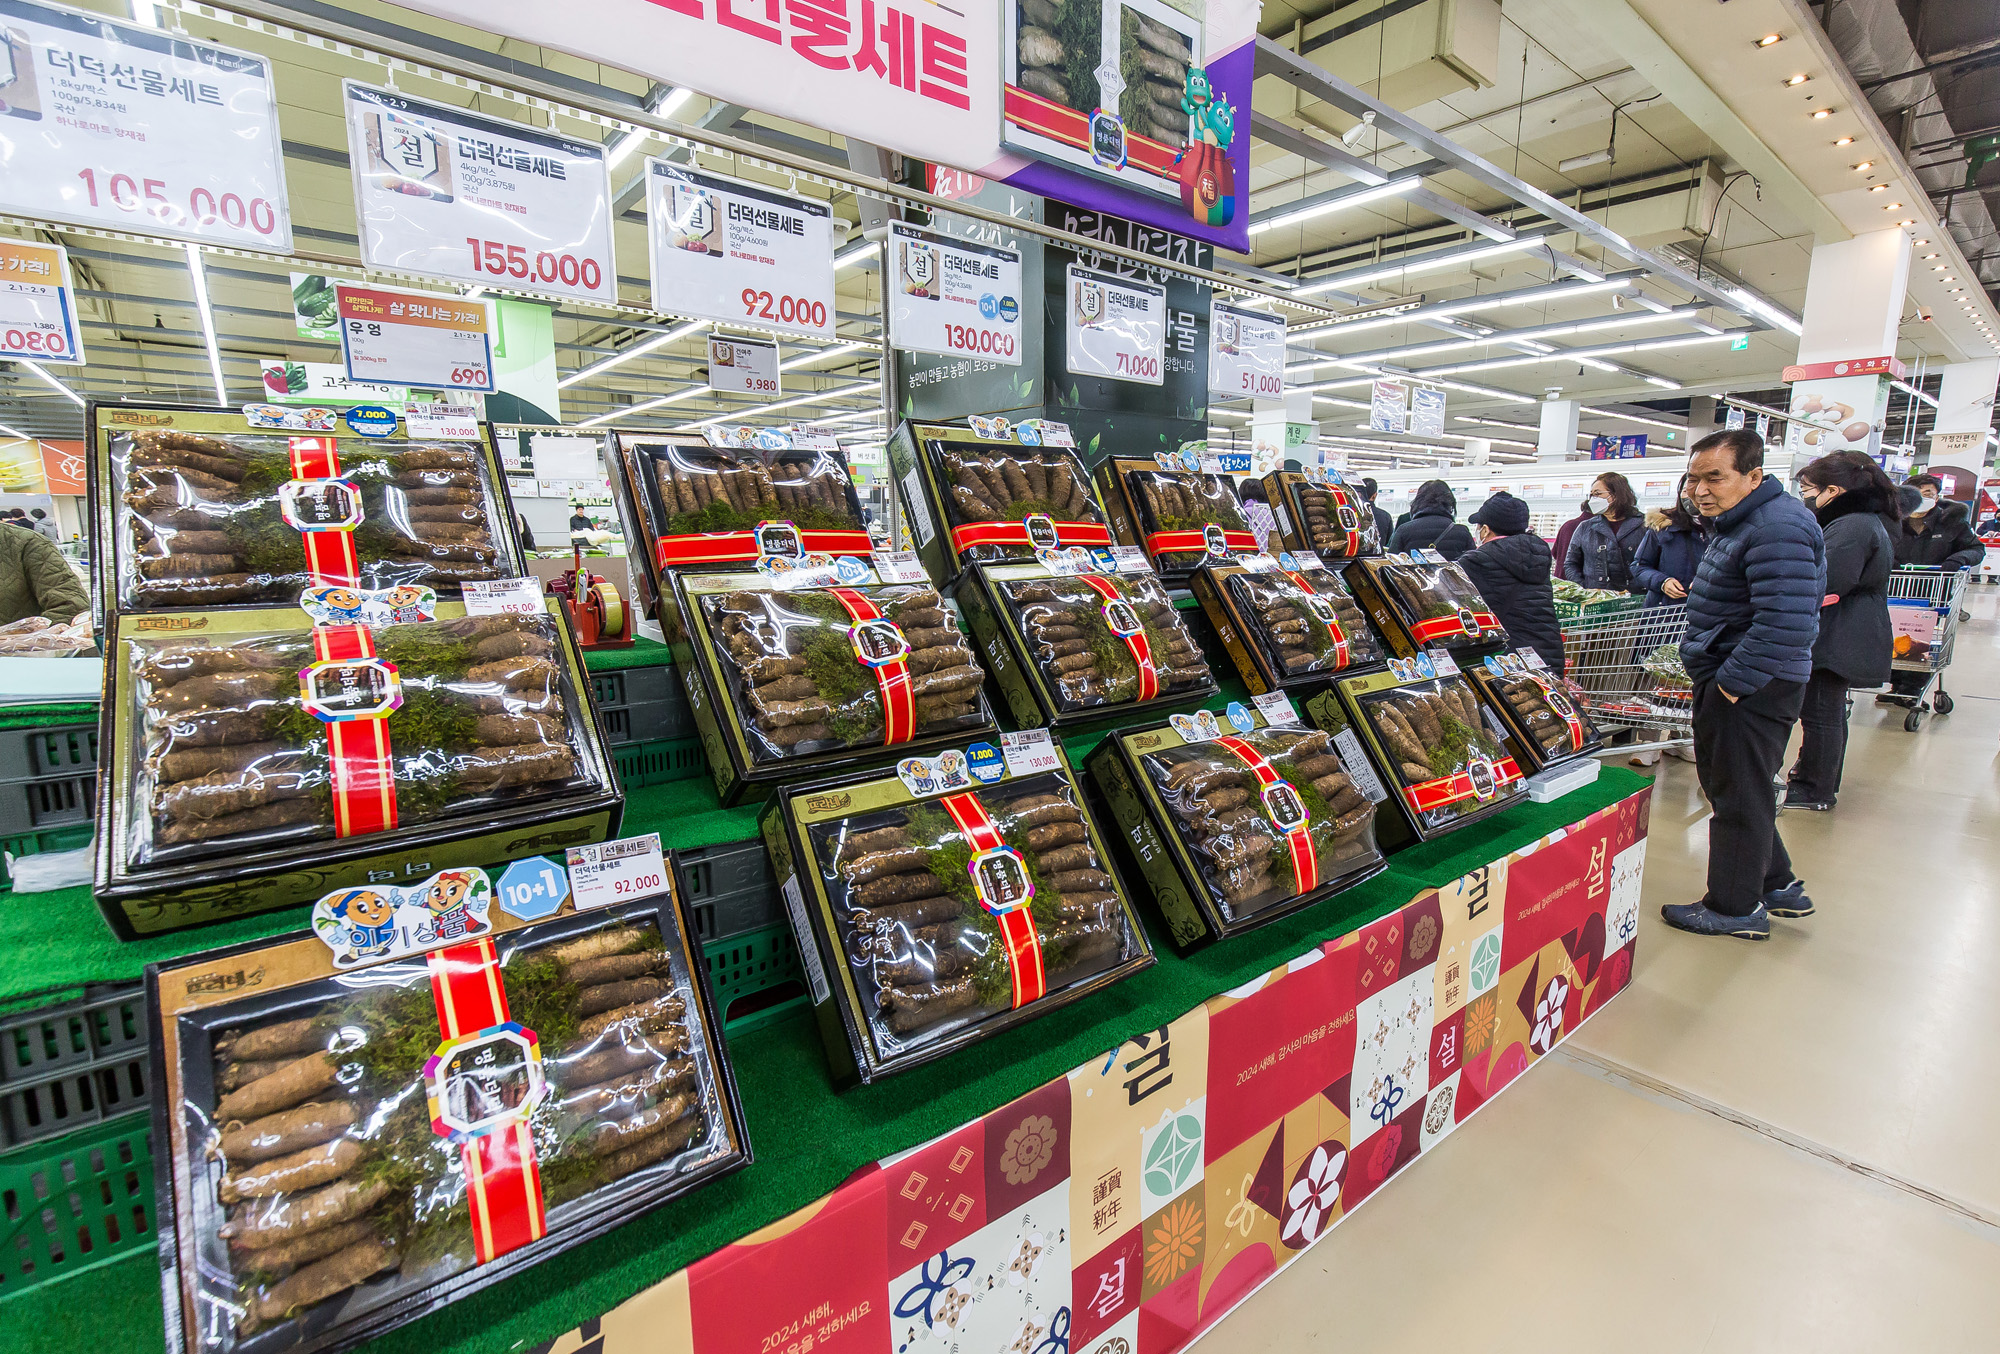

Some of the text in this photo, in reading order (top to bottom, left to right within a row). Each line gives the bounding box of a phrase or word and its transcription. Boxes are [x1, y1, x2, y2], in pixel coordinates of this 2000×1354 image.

[47, 48, 225, 107] 더덕선물세트
[54, 103, 76, 116] 국산
[56, 116, 146, 142] 하나로마트 양재점
[393, 135, 425, 169] 설
[458, 136, 566, 181] 더덕선물세트
[460, 162, 496, 177] 4kg/박스
[78, 167, 275, 235] 105,000
[463, 184, 479, 194] 국산
[1202, 178, 1215, 201] 福
[504, 202, 527, 215] 양재점
[728, 202, 804, 236] 더덕선물세트
[730, 241, 741, 250] 국산
[8, 256, 50, 276] 가격!
[466, 237, 601, 290] 155,000
[730, 251, 775, 265] 하나로마트 양재점
[912, 256, 927, 278] 설
[944, 254, 999, 280] 더덕선물세트
[345, 296, 374, 305] 대한민국
[741, 288, 826, 328] 92,000
[980, 299, 996, 314] 10+1
[1084, 293, 1096, 312] 설
[1108, 291, 1149, 312] 더덕선물세트
[389, 301, 480, 325] 살 맛나는 가격!
[1, 329, 65, 353] ,080
[945, 324, 1014, 356] 130,000
[908, 370, 928, 389] 농민이
[928, 366, 949, 384] 만들고
[950, 359, 972, 379] 농협이
[1116, 352, 1158, 377] 71,000
[451, 368, 487, 386] 690
[745, 378, 777, 391] 9,980
[1242, 373, 1281, 394] 51,000
[441, 428, 476, 437] 130,000
[1021, 431, 1038, 443] 10+1
[765, 539, 796, 549] 명품더덕
[1231, 708, 1251, 726] 10+1
[1029, 756, 1055, 768] 130,000
[604, 840, 647, 856] 선물세트
[575, 861, 622, 875] 더덕선물세트
[993, 859, 1014, 900] 명품더덕
[1583, 837, 1607, 900] 설
[505, 869, 558, 906] 10+1
[614, 874, 660, 894] 92,000
[1456, 864, 1489, 920] 설
[349, 906, 469, 958] 인기상품
[1236, 1008, 1356, 1087] 2024 새해, 감사의 마음을 전하세요
[1436, 1025, 1456, 1069] 설
[1101, 1025, 1174, 1106] 설
[1093, 1171, 1122, 1205] 謹賀
[1093, 1196, 1122, 1230] 新年
[1087, 1257, 1126, 1319] 설
[761, 1300, 834, 1354] 2024 새해,
[817, 1300, 872, 1344] 전하세요
